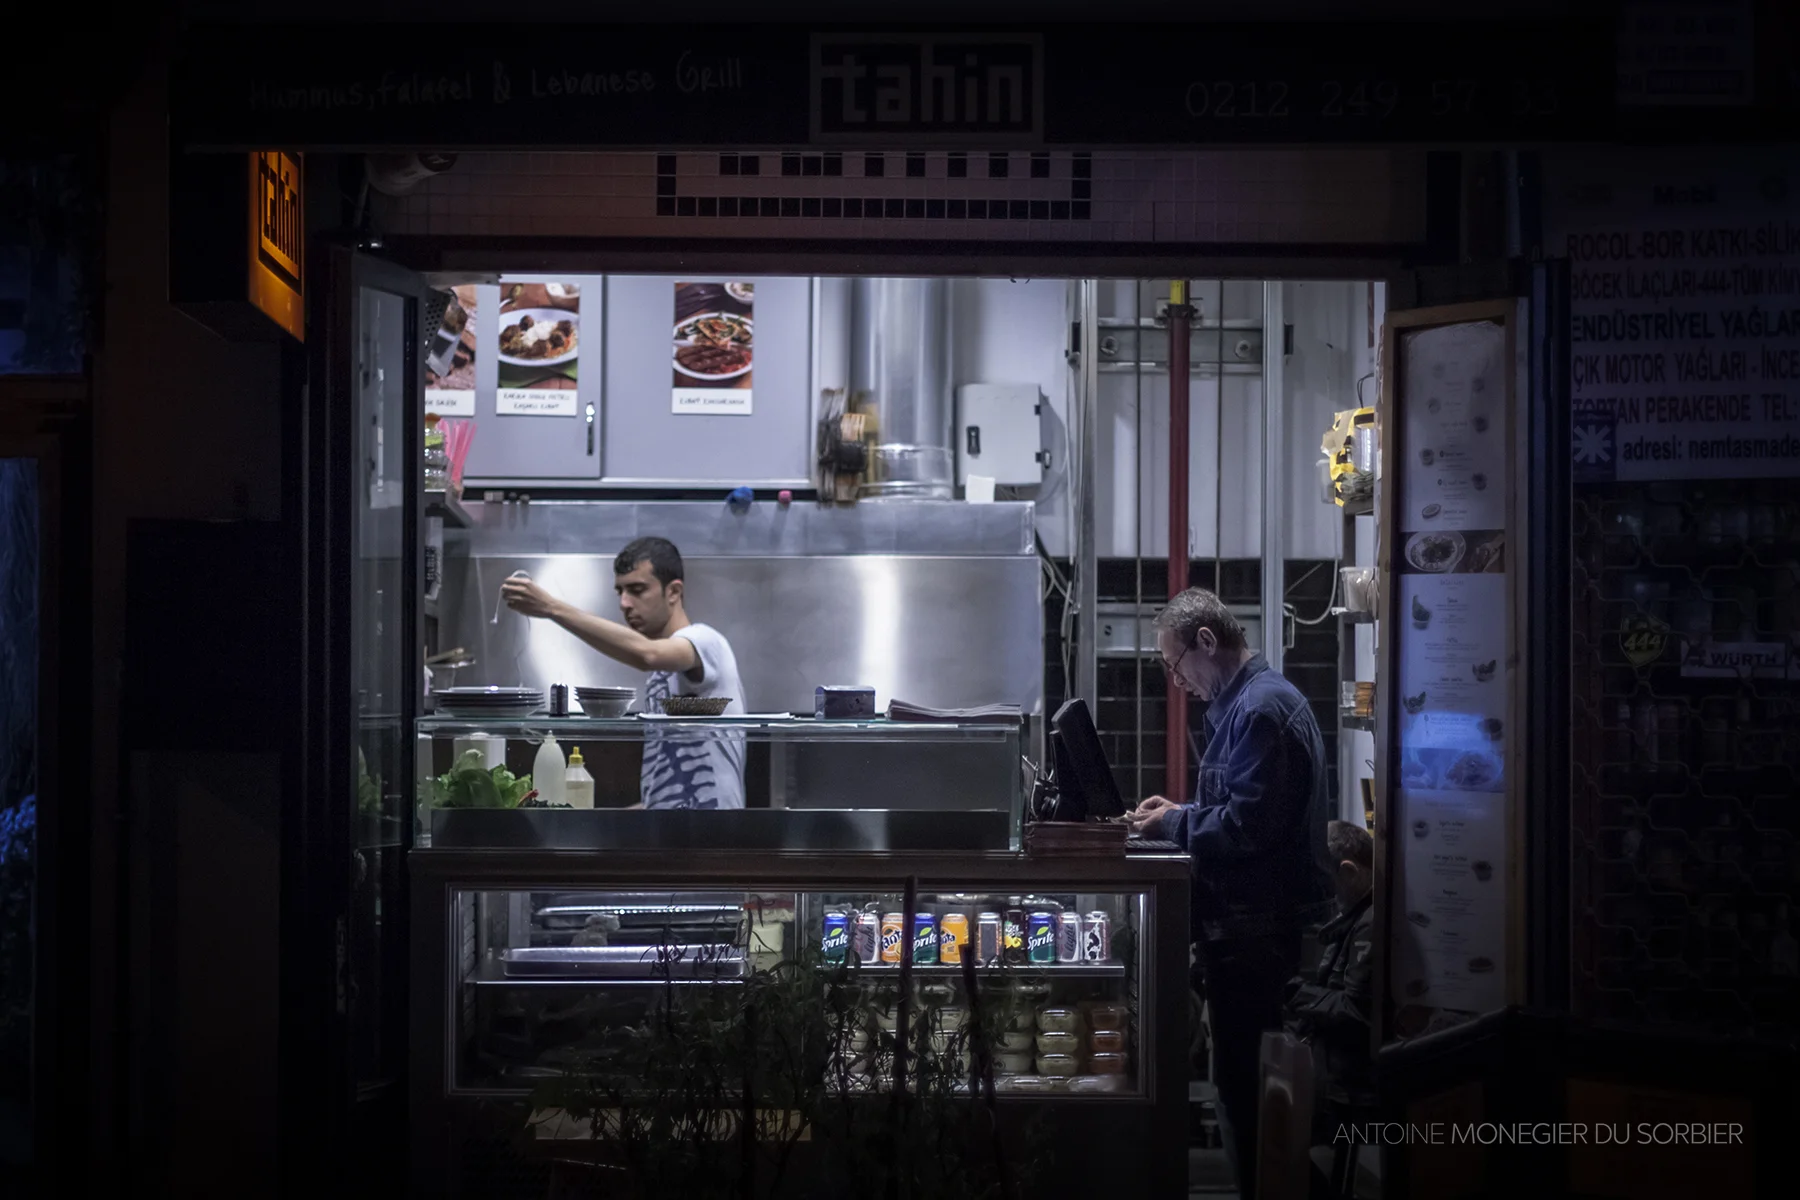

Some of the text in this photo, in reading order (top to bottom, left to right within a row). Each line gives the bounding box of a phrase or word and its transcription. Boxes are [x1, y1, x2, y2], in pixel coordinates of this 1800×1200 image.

[531, 67, 656, 97] Lebanese
[822, 44, 1024, 123] tahin
[1184, 79, 1290, 118] 0212
[1321, 80, 1399, 118] 249
[1430, 78, 1478, 116] 57
[1572, 306, 1715, 341] ENDÜSTRİYEL
[1605, 352, 1665, 385] MOTOR
[1673, 347, 1746, 382] YAĞLARI
[1646, 393, 1751, 423] PERAKENDE
[1624, 435, 1683, 461] adresi:
[1622, 632, 1662, 651] 444
[821, 932, 848, 952] Sprite
[913, 932, 937, 951] prite
[1028, 932, 1054, 951] Sprite
